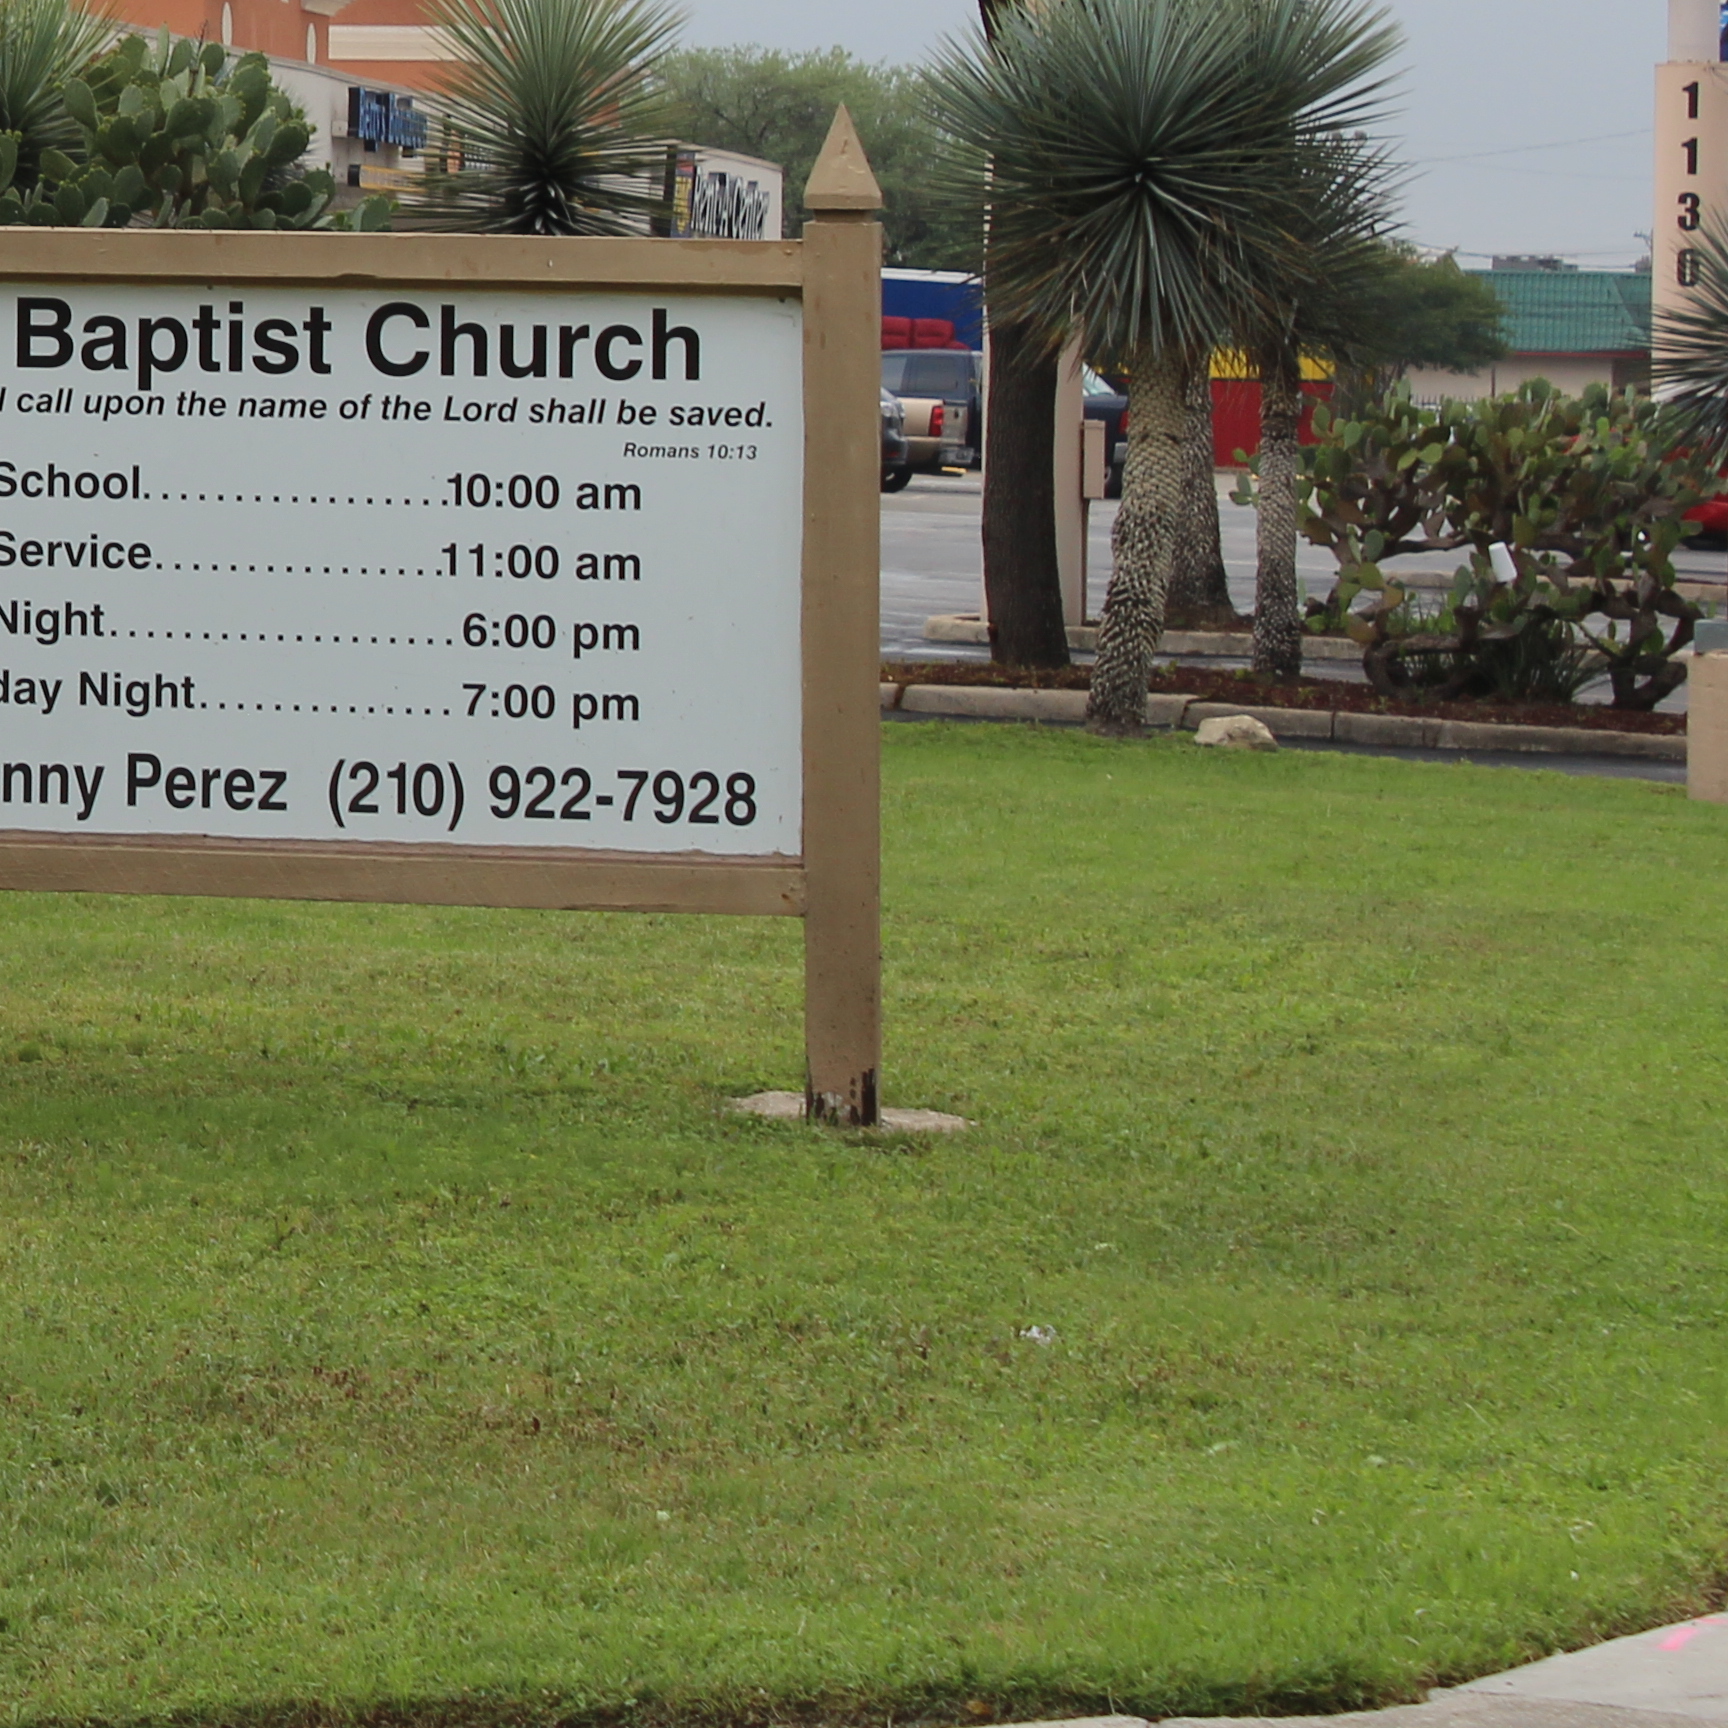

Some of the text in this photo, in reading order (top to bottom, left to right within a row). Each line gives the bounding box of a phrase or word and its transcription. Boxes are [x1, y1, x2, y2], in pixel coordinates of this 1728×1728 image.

[16, 296, 332, 392] Baptist
[365, 301, 700, 381] Church
[16, 387, 74, 414] call
[83, 394, 165, 422] upon
[177, 390, 227, 417] the
[238, 397, 327, 420] name
[339, 393, 373, 420] of
[381, 394, 432, 421] the
[443, 395, 518, 423] Lord
[528, 397, 606, 424] shall
[616, 398, 657, 426] be
[669, 401, 772, 428] saved.
[623, 442, 757, 460] Romans 10:13
[447, 472, 560, 510] 10:00
[576, 482, 641, 511] am
[441, 542, 559, 580] 11:00
[575, 553, 641, 581] am
[463, 612, 556, 649] 6:00
[573, 622, 640, 660] pm
[462, 683, 556, 719] 7:00
[573, 693, 639, 730] pm
[127, 752, 288, 811] Perez
[328, 758, 465, 832] (210)
[489, 765, 757, 827] 922-7928
